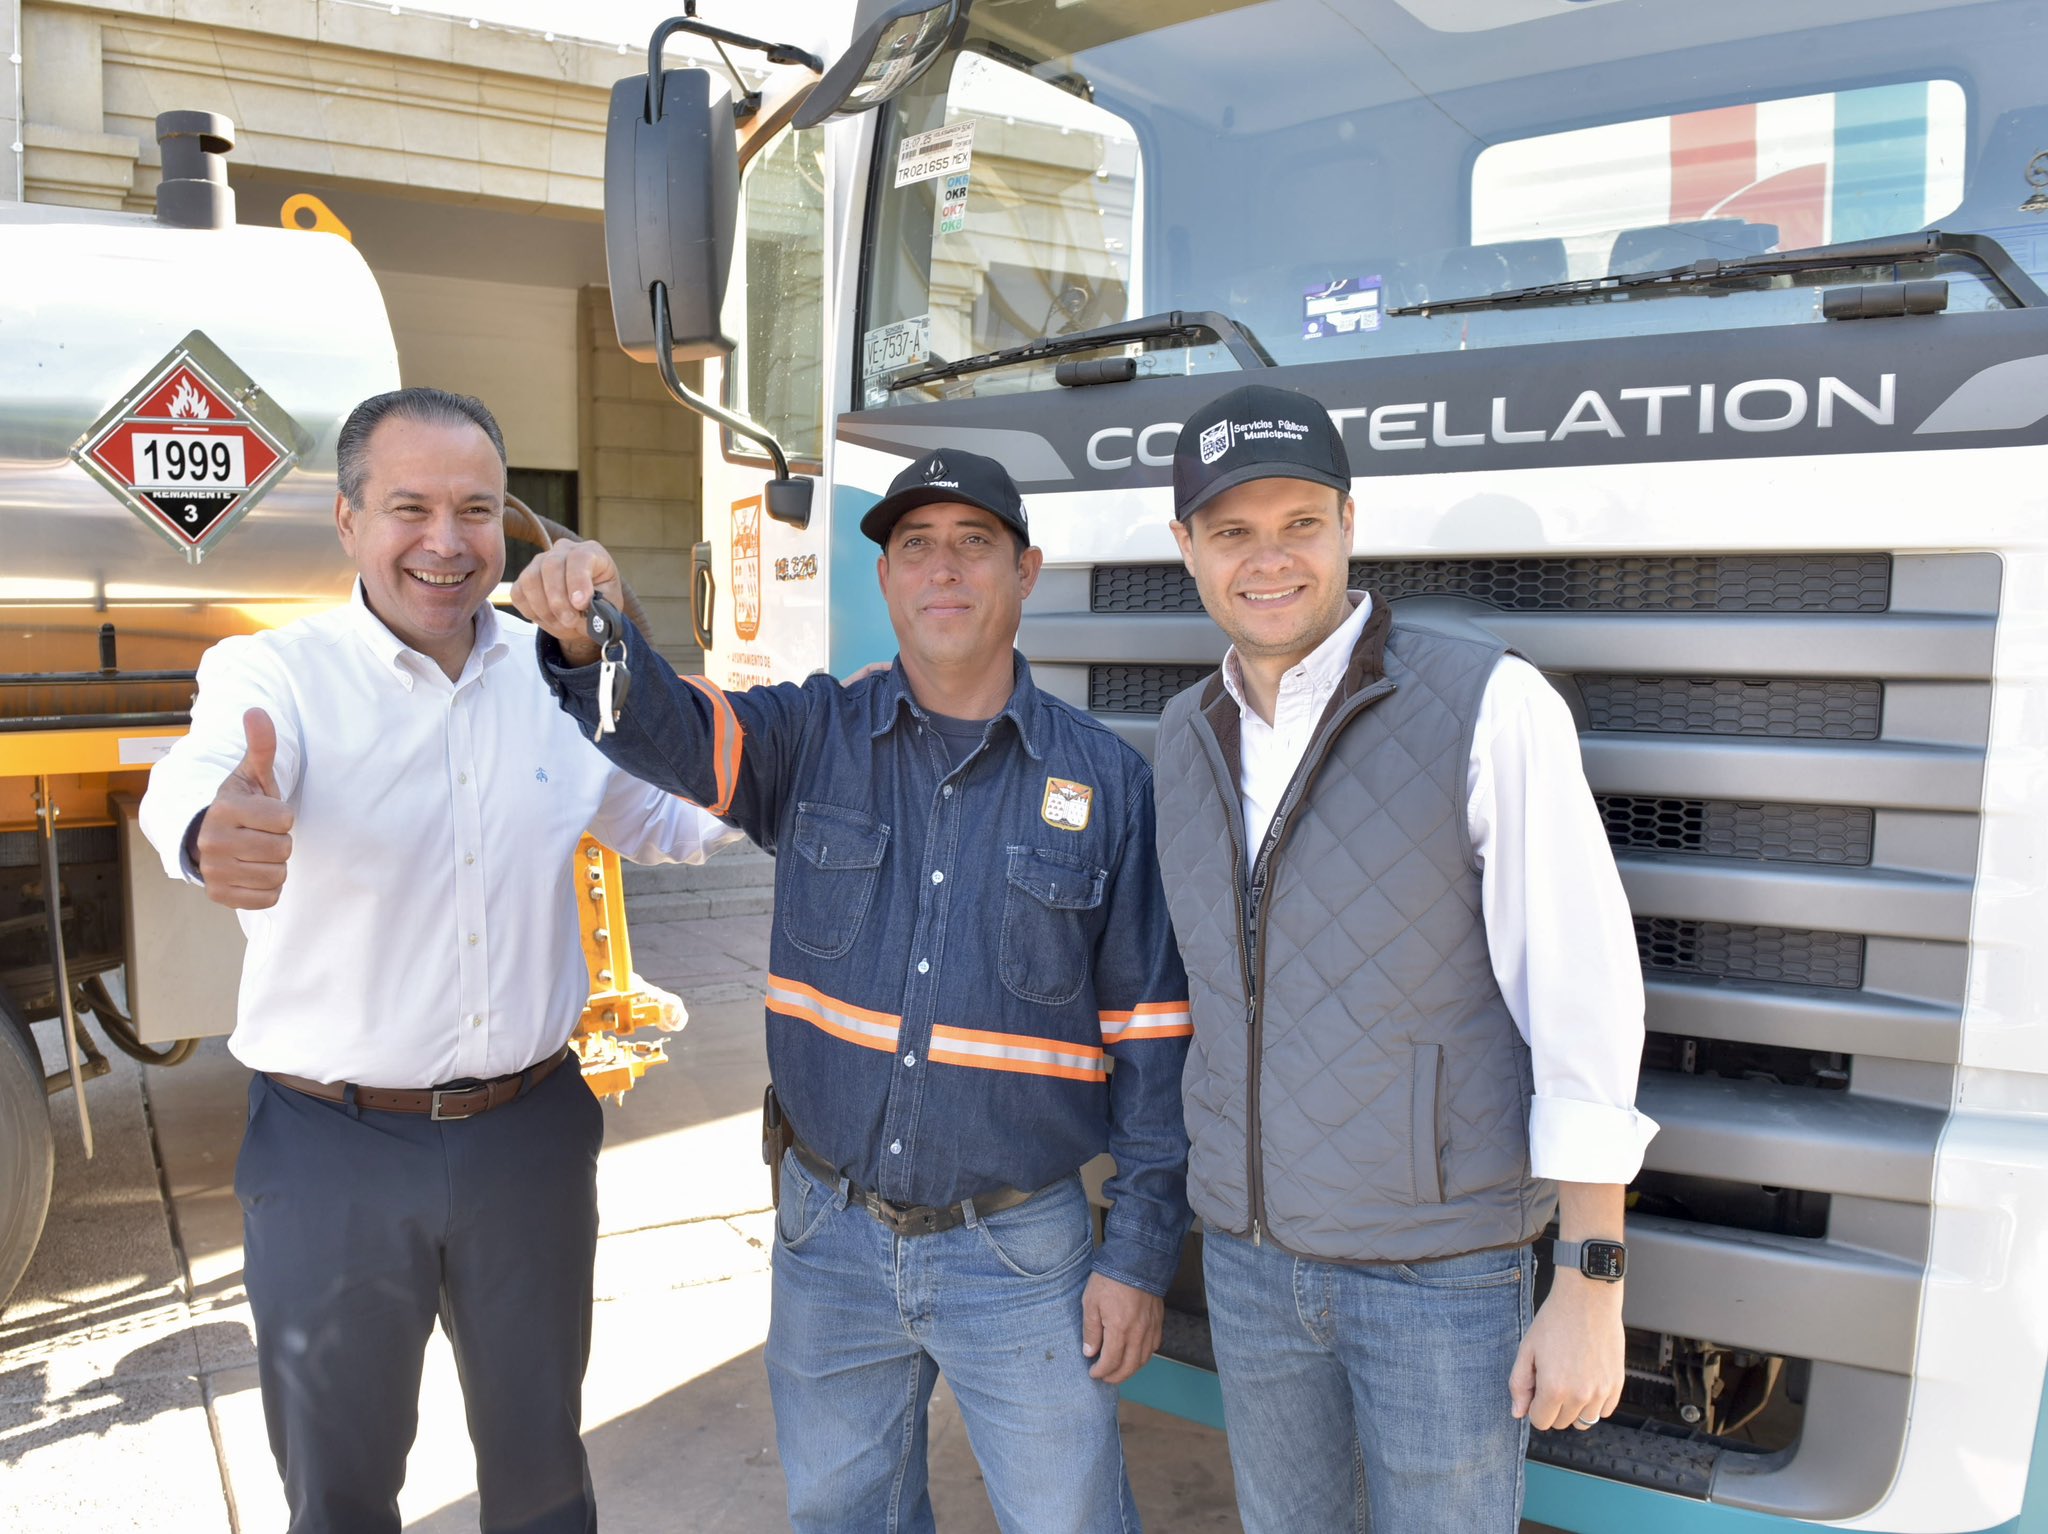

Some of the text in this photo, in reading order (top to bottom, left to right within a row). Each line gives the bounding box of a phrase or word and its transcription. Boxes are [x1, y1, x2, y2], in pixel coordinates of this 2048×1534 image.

[898, 152, 969, 181] TR021655 MEX
[945, 187, 967, 200] OKR
[943, 203, 964, 217] OK7
[867, 329, 920, 365] VE-7537-A
[1086, 373, 1896, 470] COTELLATION
[1234, 420, 1273, 433] Servicios
[1243, 430, 1303, 440] Municipales
[144, 440, 230, 482] 1999
[184, 504, 199, 523] 3
